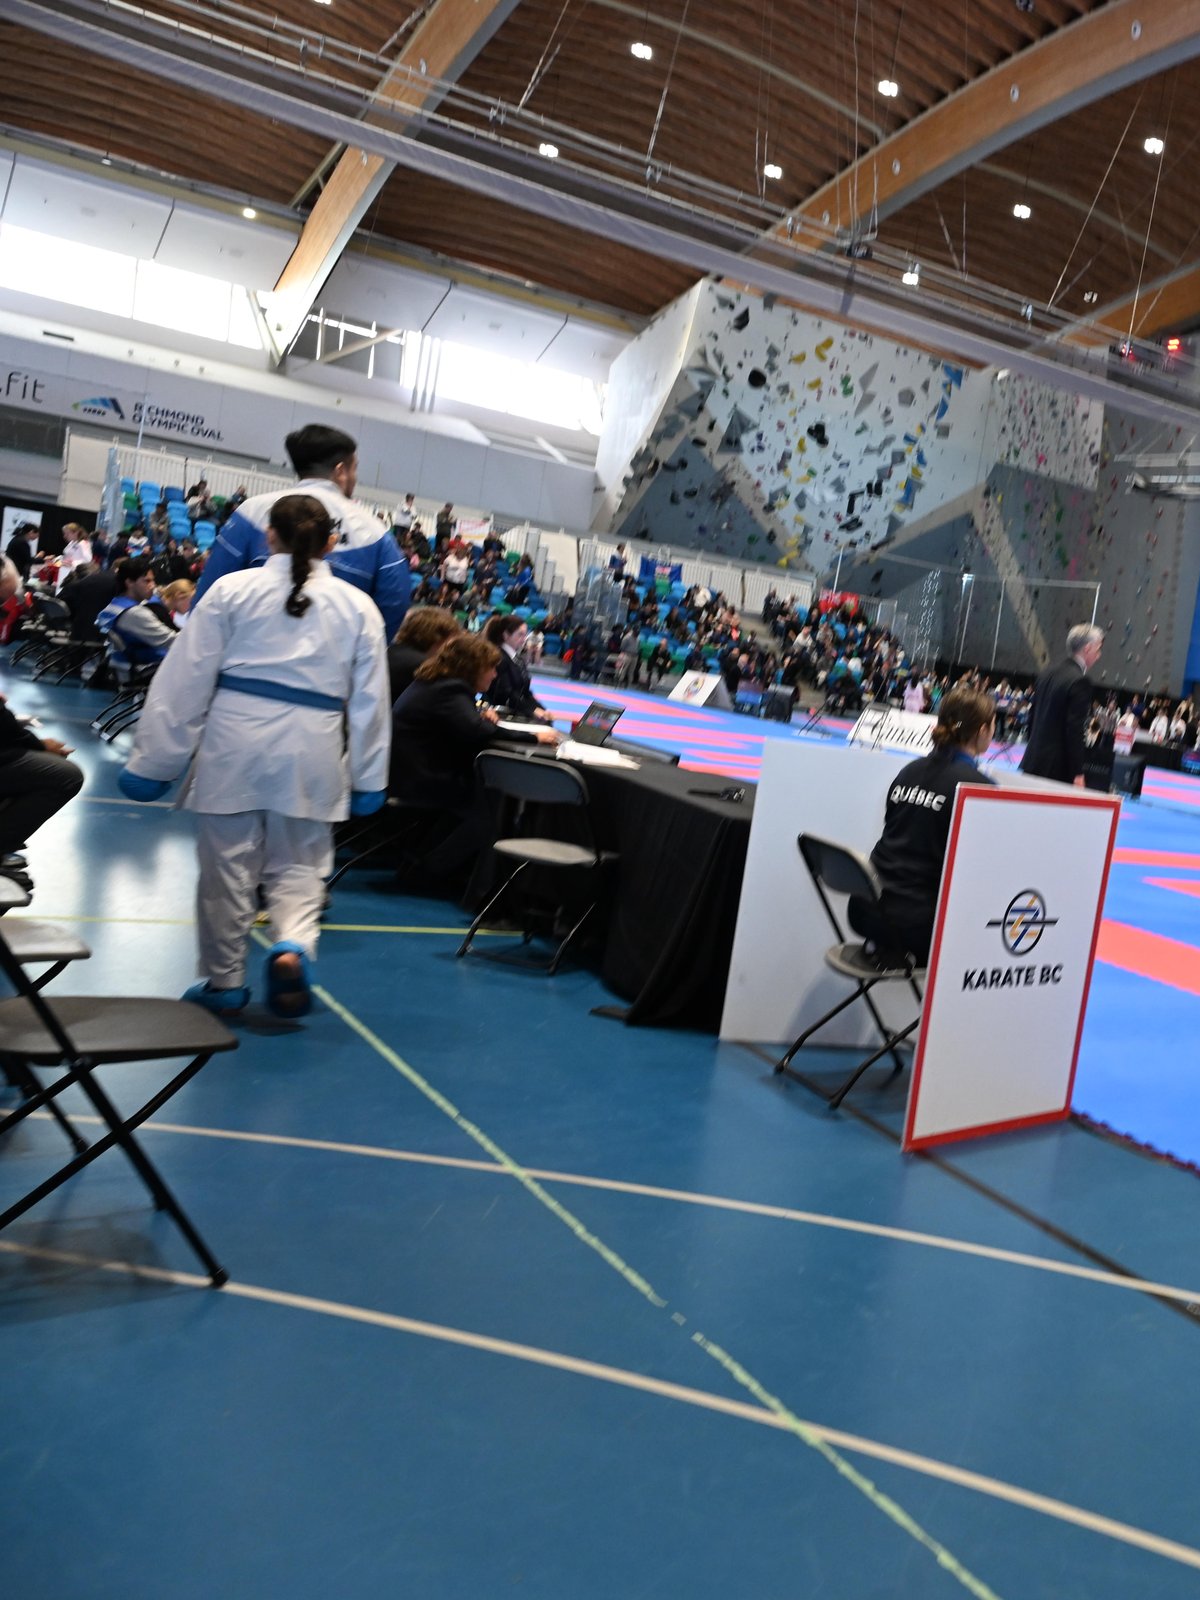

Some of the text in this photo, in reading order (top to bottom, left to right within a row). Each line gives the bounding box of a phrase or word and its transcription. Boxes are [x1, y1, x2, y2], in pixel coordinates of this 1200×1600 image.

[134, 402, 205, 426] RCHMOND
[190, 425, 224, 442] OVAL
[890, 785, 947, 811] QUÉBEC
[961, 963, 1064, 992] KARATE BC
